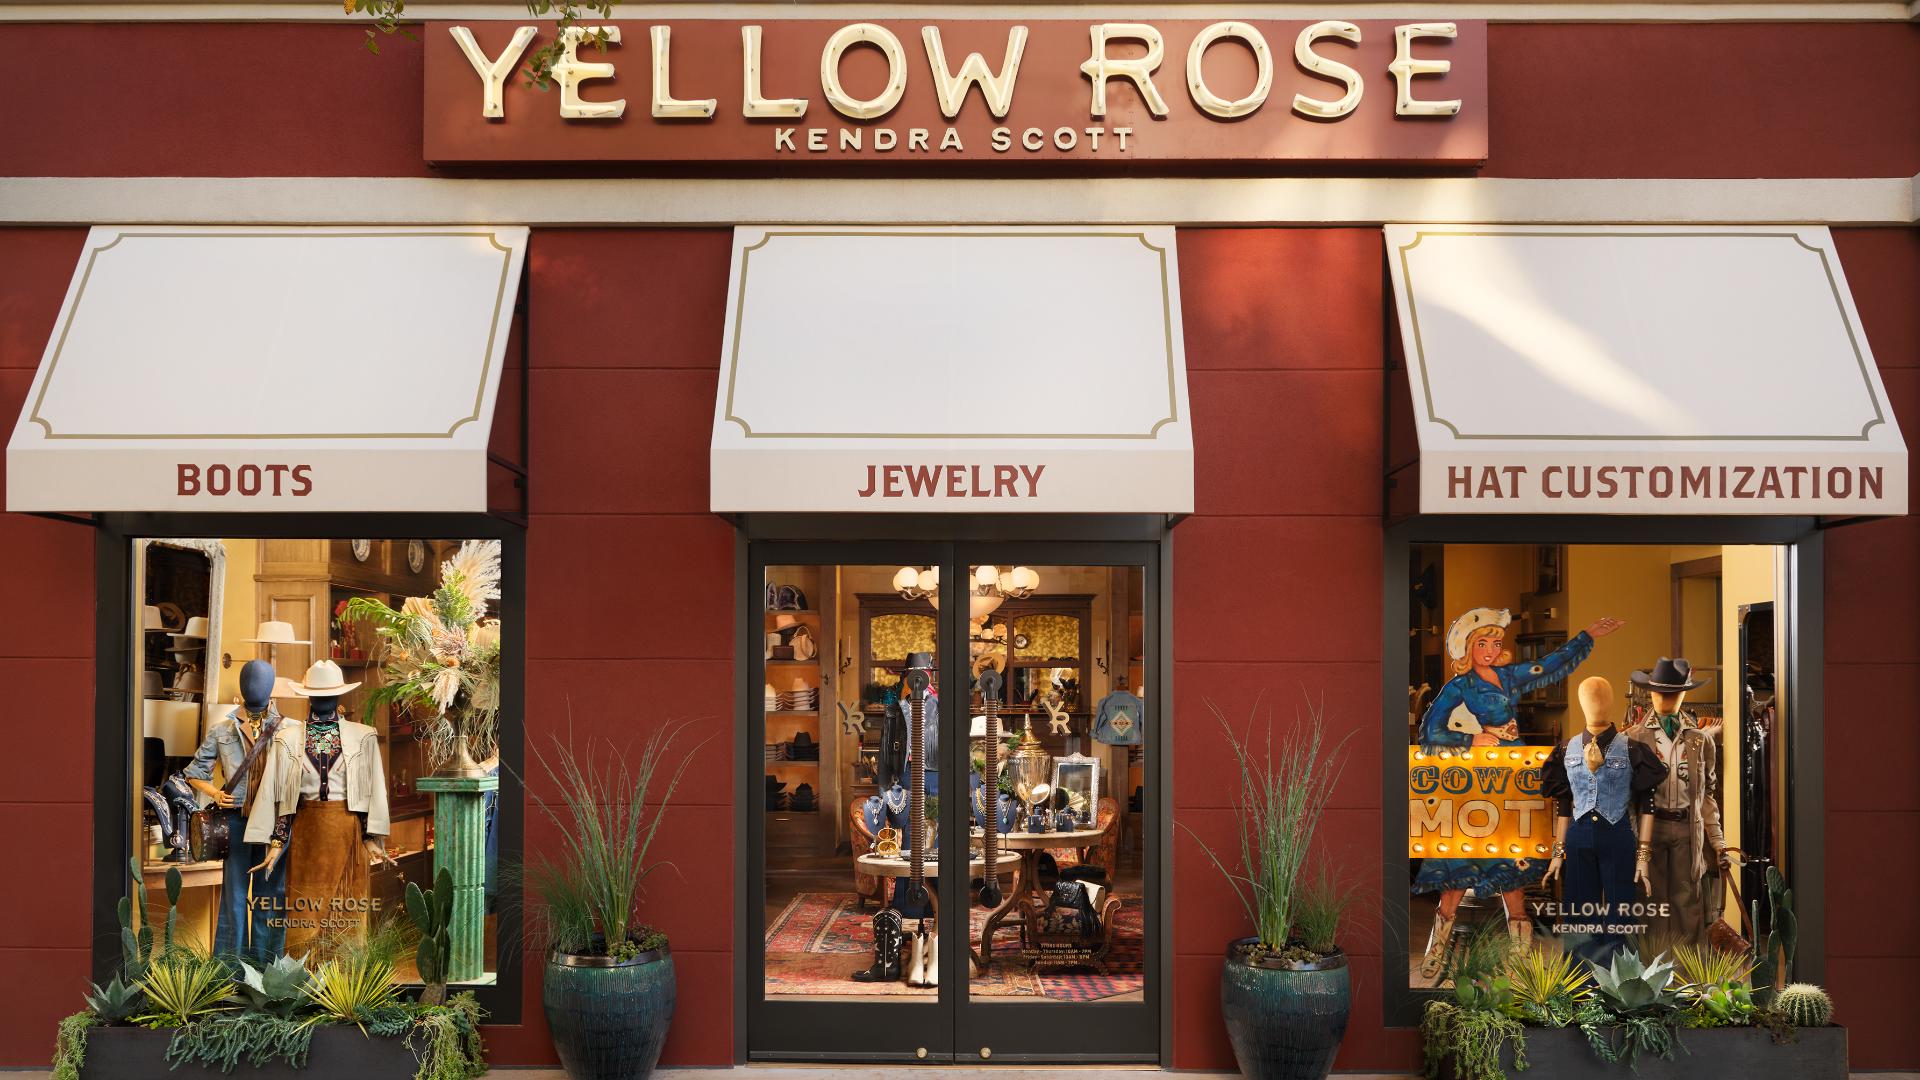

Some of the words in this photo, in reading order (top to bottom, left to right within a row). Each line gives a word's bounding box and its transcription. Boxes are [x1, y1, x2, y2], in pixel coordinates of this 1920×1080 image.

[449, 23, 1028, 119] YELLOW
[1080, 20, 1462, 119] ROSE
[774, 127, 963, 151] KENDRA
[991, 127, 1133, 151] SCOTT
[177, 464, 313, 496] BOOTS
[858, 465, 1046, 498] JEWELRY
[1448, 466, 1527, 499] HAT
[1541, 466, 1884, 500] CUSTOMIZATION
[1410, 799, 1558, 838] MOT
[246, 896, 323, 912] YELLOW
[329, 897, 382, 912] ROSE
[1532, 902, 1611, 917] YELLOW
[1617, 902, 1671, 918] ROSE
[266, 918, 316, 929] KENDRA
[320, 918, 361, 929] SCOTT
[1552, 924, 1604, 934] KENDRA
[1607, 924, 1648, 935] SCOTT
